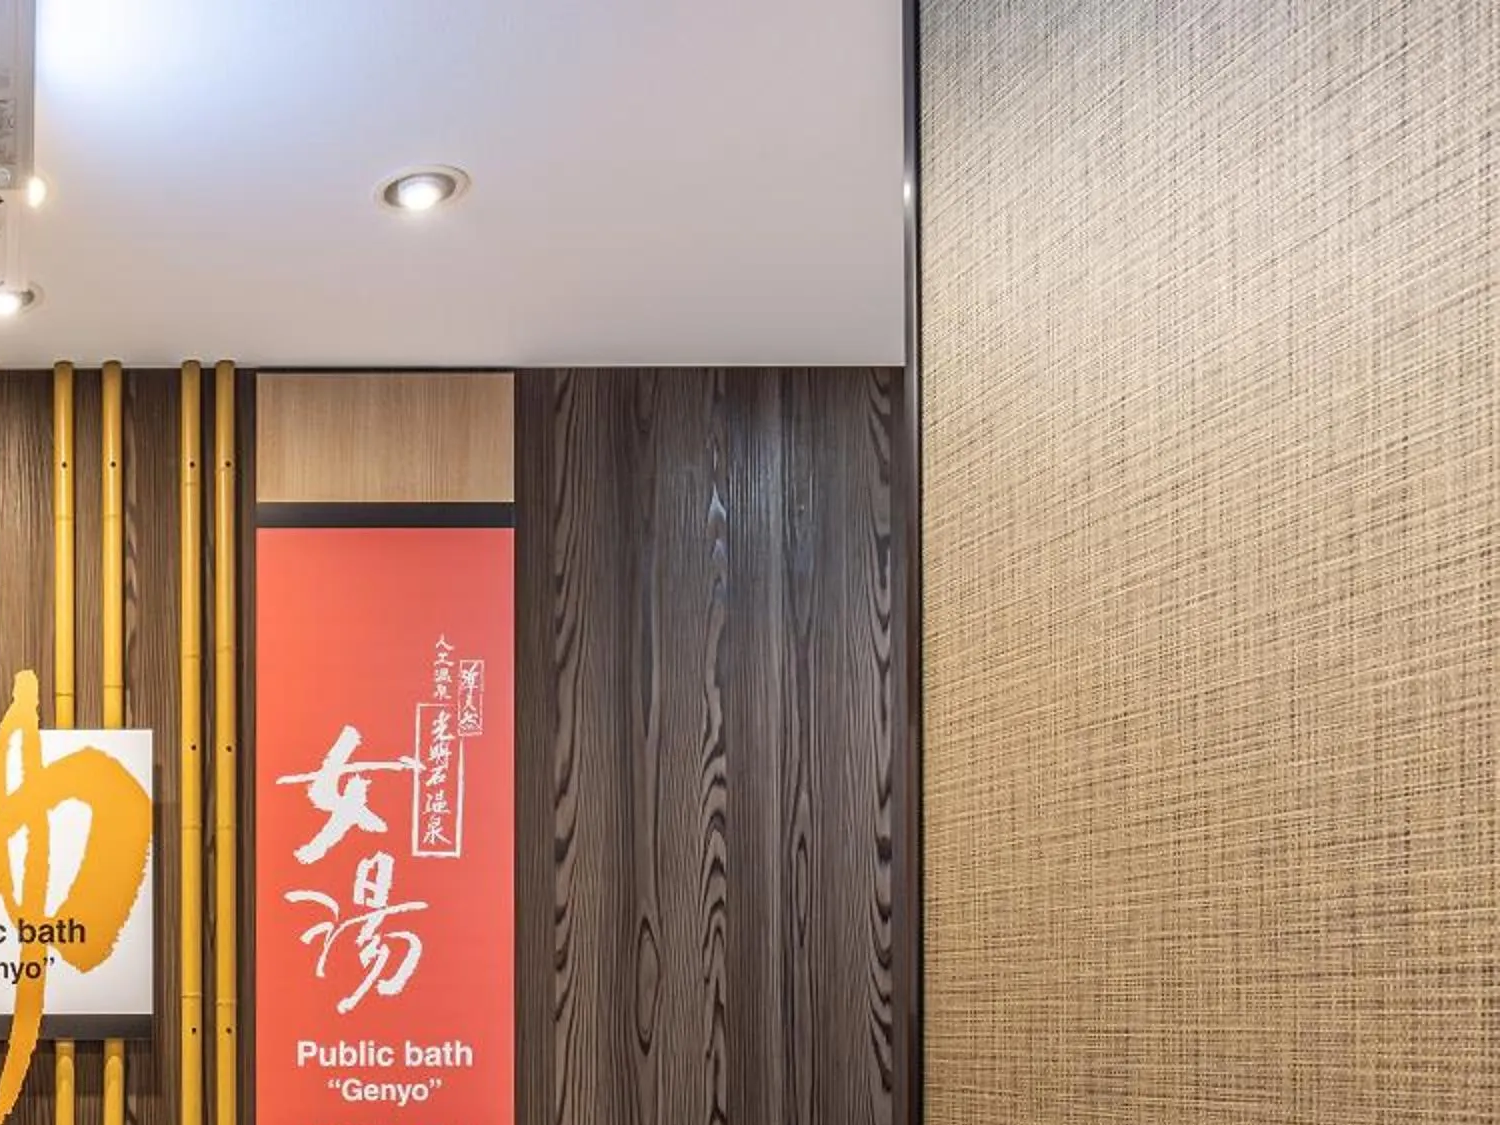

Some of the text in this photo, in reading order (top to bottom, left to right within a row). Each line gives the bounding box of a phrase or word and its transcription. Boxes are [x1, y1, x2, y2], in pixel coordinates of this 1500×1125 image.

[434, 634, 454, 700] 人工温泉
[276, 725, 428, 1014] 女湯
[18, 919, 86, 943] bath
[297, 1041, 473, 1067] Public bath
[328, 1079, 442, 1106] “Genyo”
